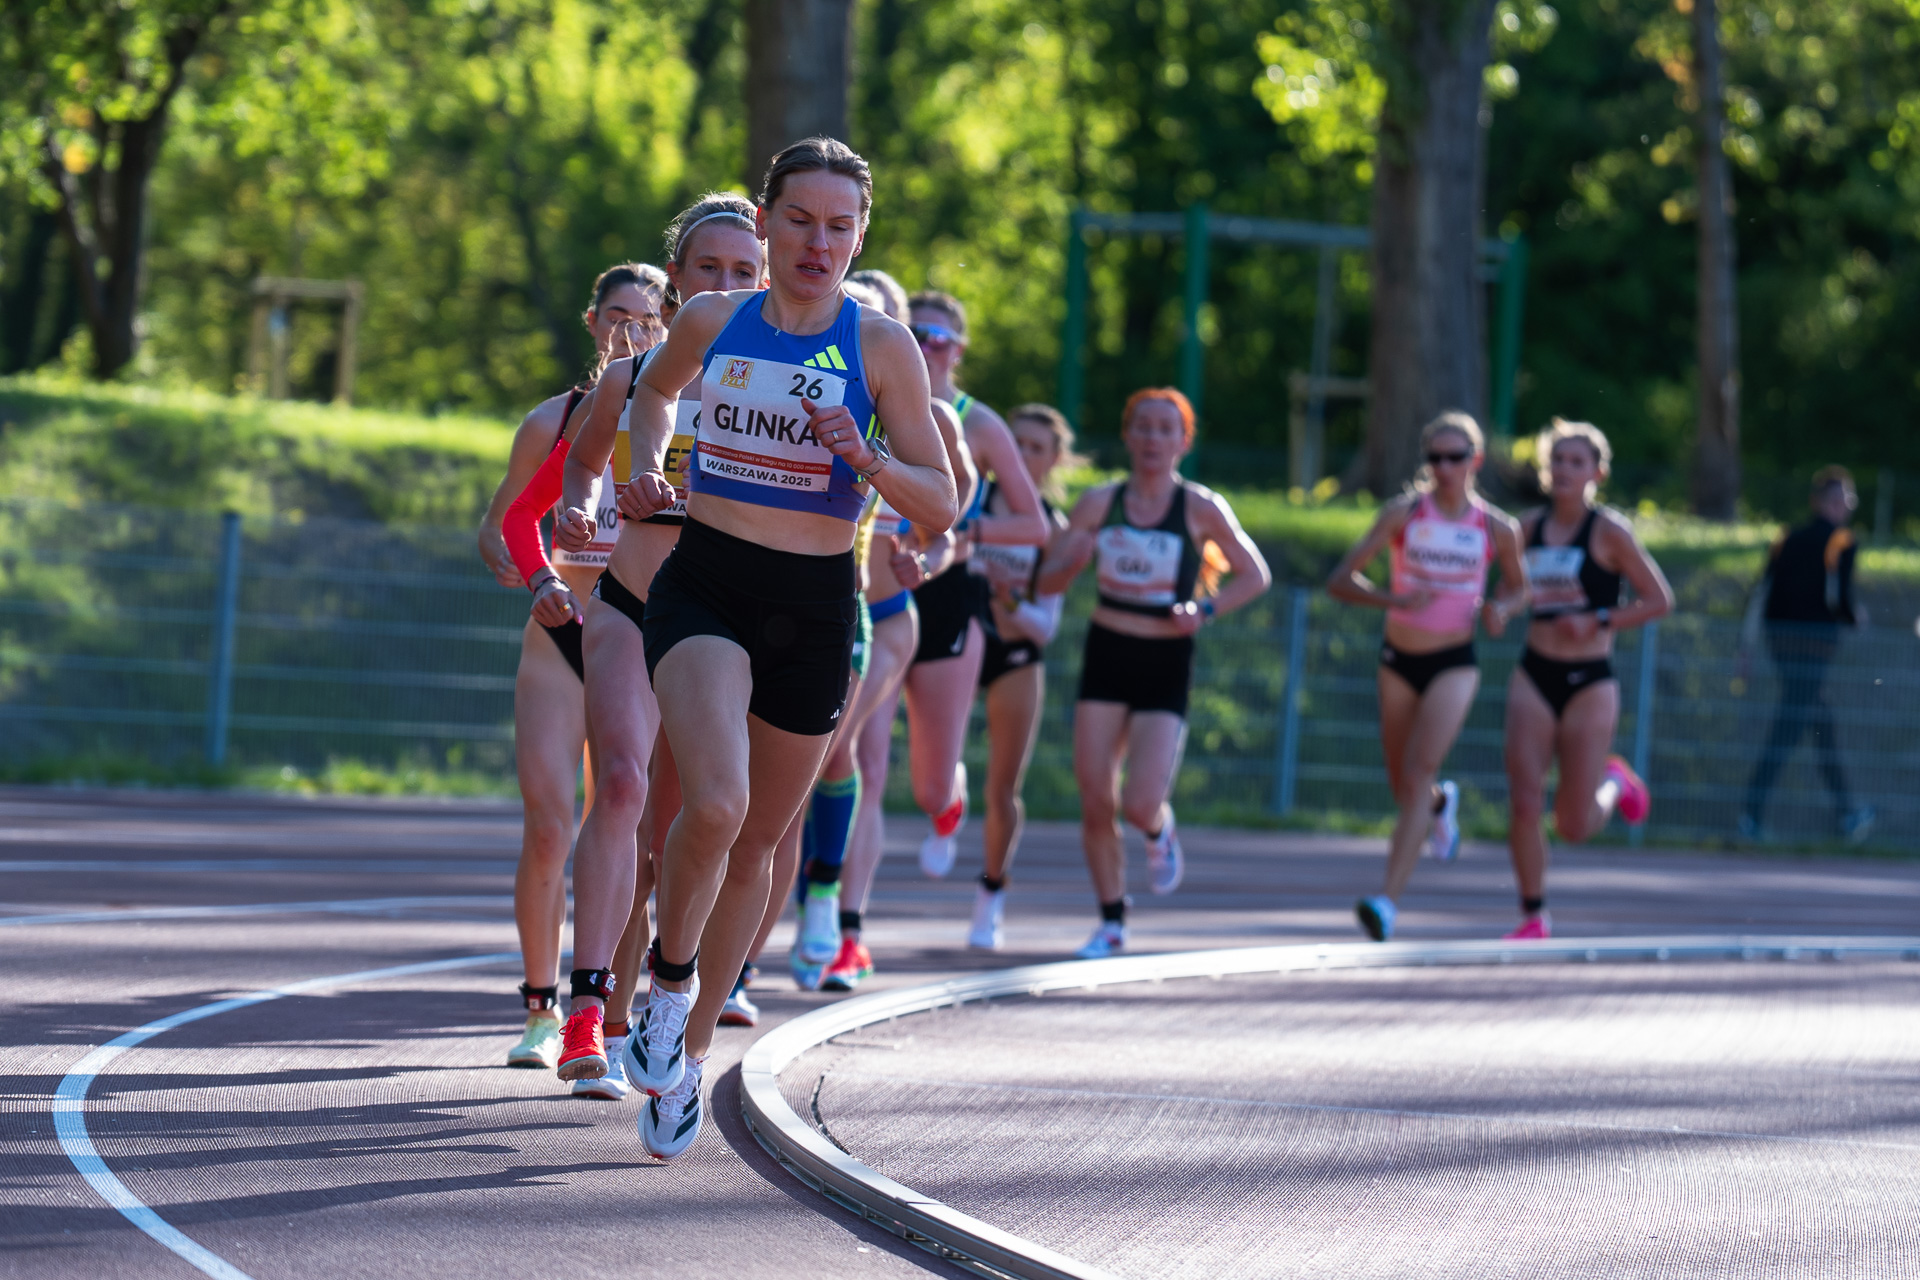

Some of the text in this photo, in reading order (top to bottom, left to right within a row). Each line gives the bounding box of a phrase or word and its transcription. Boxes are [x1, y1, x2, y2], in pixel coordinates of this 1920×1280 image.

[788, 373, 824, 400] 26
[714, 403, 820, 447] GLINKA
[711, 447, 738, 458] Mistrzostwa
[738, 453, 755, 461] Polski
[761, 458, 777, 466] Biegu
[706, 458, 778, 483] WARSZAWA
[780, 474, 812, 487] 2025
